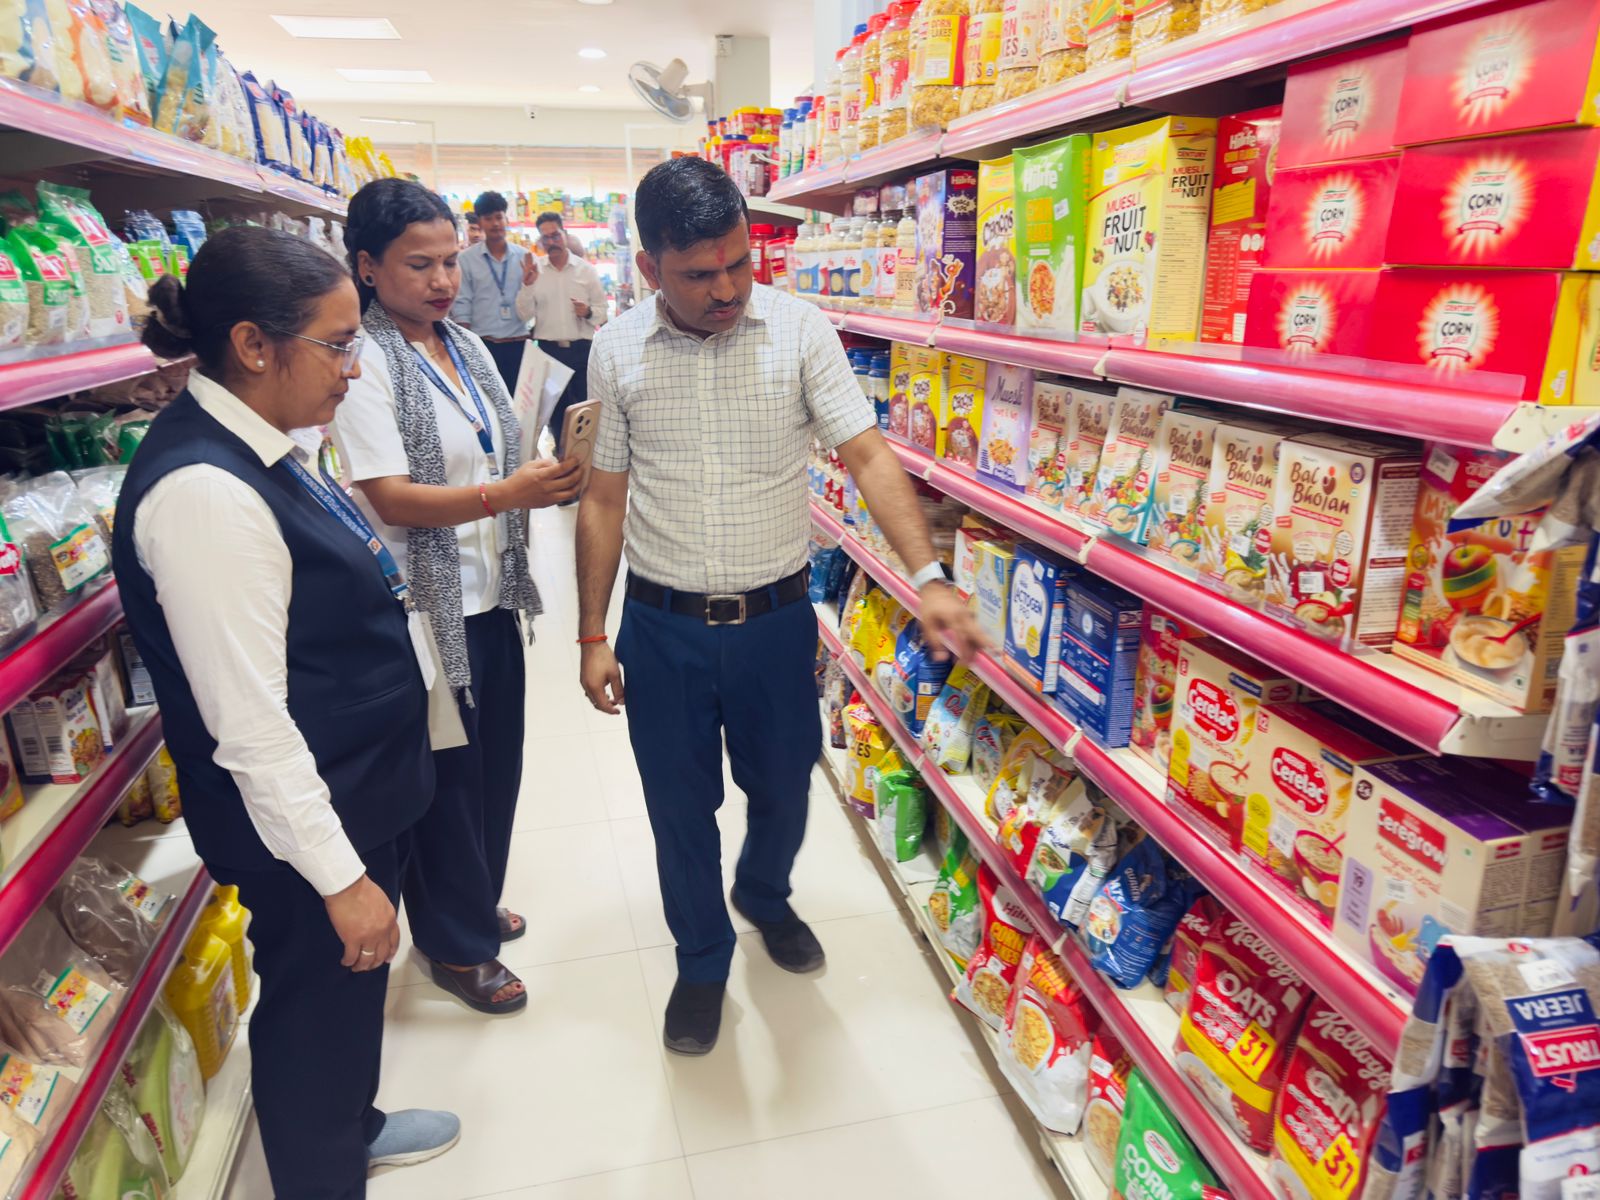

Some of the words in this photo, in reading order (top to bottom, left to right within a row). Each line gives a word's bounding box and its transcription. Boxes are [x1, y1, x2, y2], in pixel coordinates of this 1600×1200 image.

[1334, 96, 1360, 113] CORN
[1171, 173, 1211, 189] FRUIT
[1172, 165, 1206, 175] MUESLI
[1106, 191, 1142, 214] MUESLI
[1182, 186, 1206, 199] NUT
[1468, 192, 1503, 211] CORN
[1103, 205, 1147, 238] FRUIT
[1320, 208, 1345, 222] CORN
[1114, 230, 1143, 255] NUT
[1293, 313, 1317, 327] CORN
[1441, 321, 1473, 337] CORN
[1120, 402, 1138, 420] Bal
[1168, 427, 1190, 447] Bal
[1169, 445, 1212, 470] Bhojan
[1225, 441, 1251, 464] Bal
[1226, 461, 1273, 490] Bhojan
[1290, 460, 1318, 485] Bal
[1292, 482, 1350, 515] Bhojan
[1188, 688, 1235, 732] Cerelac
[1272, 757, 1324, 804] Cerelac
[1376, 807, 1448, 867] Ceregrow
[1124, 867, 1141, 902] QUAKER
[1216, 970, 1278, 1029] OATS
[1513, 993, 1584, 1020] JEERA
[1239, 1029, 1270, 1067] 31
[1533, 1038, 1600, 1069] TRUST
[1323, 1144, 1356, 1191] 31
